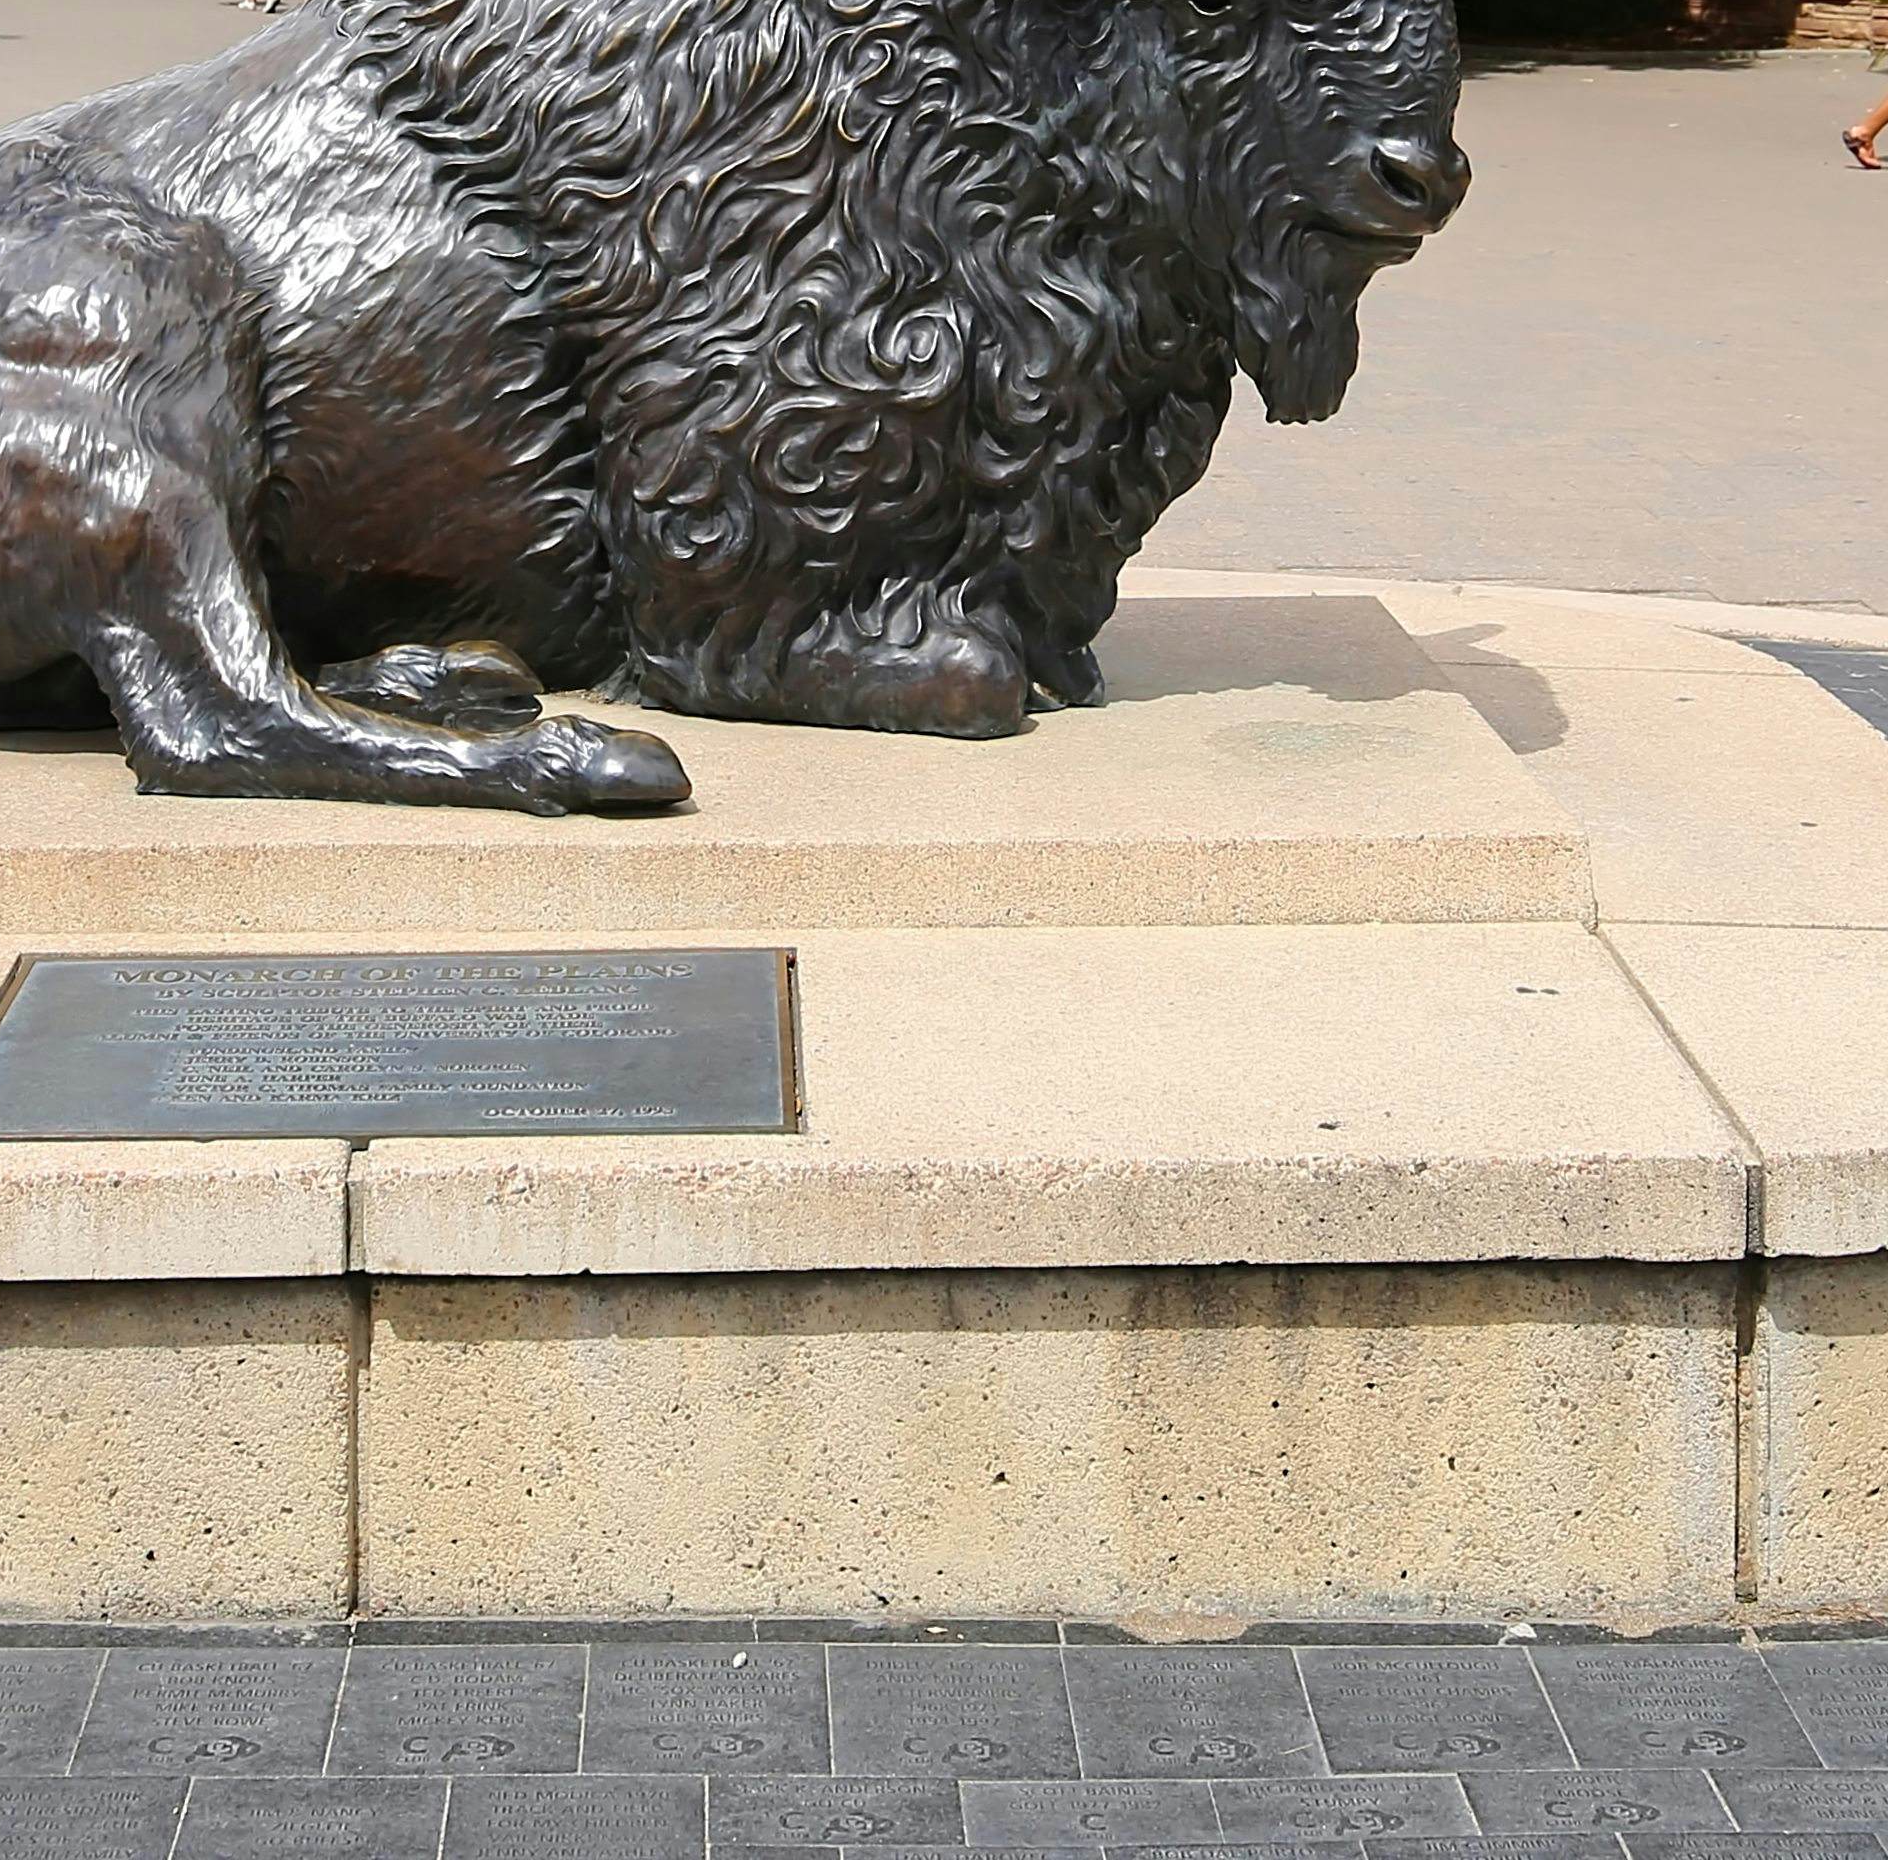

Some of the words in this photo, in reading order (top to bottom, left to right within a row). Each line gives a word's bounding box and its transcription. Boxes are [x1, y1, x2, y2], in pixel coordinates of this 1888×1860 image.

[114, 968, 346, 983] MONARCH
[359, 967, 418, 981] OF
[435, 965, 522, 980] THE
[535, 963, 693, 979] PLAINS
[156, 988, 193, 999] BY
[201, 987, 342, 998] SCULPTOR
[186, 1006, 274, 1015] LASTING
[285, 1006, 370, 1015] TRIBUTE
[380, 1005, 406, 1014] TO
[414, 1004, 456, 1014] THE
[462, 1004, 528, 1013] SPIRIT
[534, 1003, 578, 1013] AND
[186, 1015, 292, 1024] HERITAGE
[299, 1014, 328, 1023] OF
[336, 1014, 376, 1024] THE
[385, 1013, 477, 1022] BUFFALO
[485, 1012, 528, 1021] WAS
[534, 1012, 596, 1021] MADE
[174, 1023, 271, 1032] POSSIBLE
[280, 1023, 307, 1032] BY
[316, 1022, 357, 1032] THE
[364, 1022, 496, 1031] GENEROSITY
[503, 1021, 530, 1030] OF
[537, 1021, 604, 1030] THESE
[212, 1032, 300, 1041] FRIENDS
[308, 1032, 335, 1041] OF
[346, 1031, 385, 1041] THE
[393, 1029, 518, 1040] UNIVERSITY
[525, 1029, 552, 1039] OF
[182, 1055, 247, 1065] JERRY
[280, 1055, 381, 1064] ROBINSON
[209, 1064, 255, 1073] NEIL
[261, 1064, 302, 1073] AND
[310, 1064, 405, 1073] CAROLYN
[175, 1075, 227, 1084] JUNE
[261, 1074, 342, 1083] HARPER
[173, 1084, 249, 1093] VICTOR
[285, 1083, 370, 1092] THOMAS
[220, 1094, 262, 1103] AND
[269, 1093, 340, 1103] KARMA
[482, 1106, 588, 1118] OCTOBER
[170, 1661, 278, 1672] BASKETBALL
